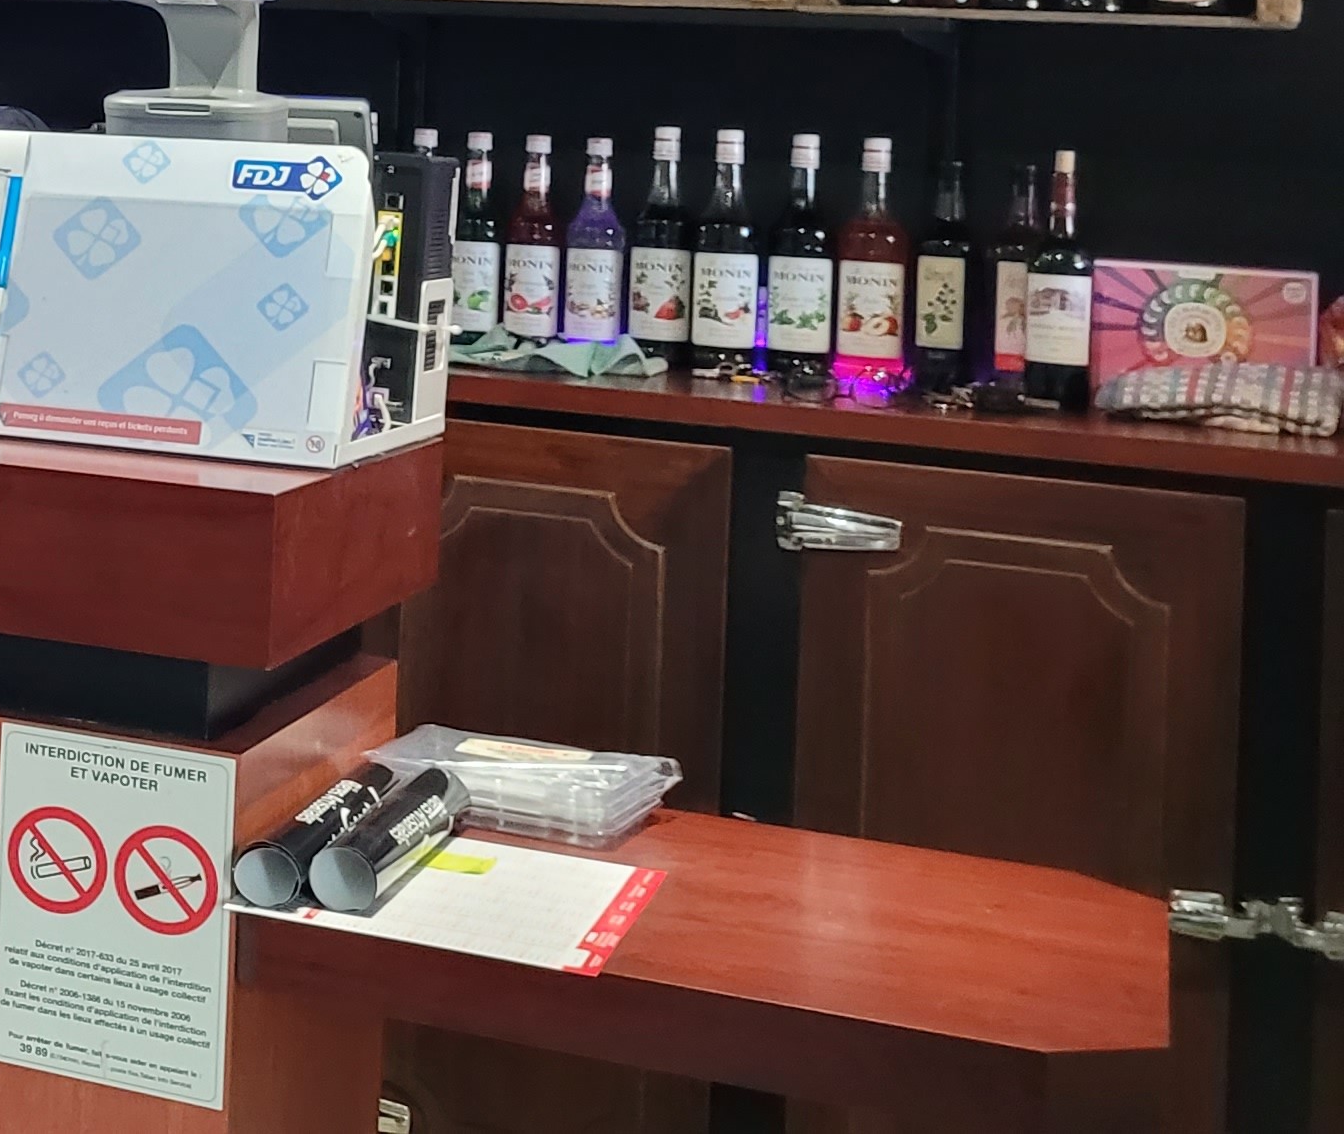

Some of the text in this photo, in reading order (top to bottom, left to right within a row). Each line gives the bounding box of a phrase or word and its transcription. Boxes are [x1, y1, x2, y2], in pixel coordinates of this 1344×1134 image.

[236, 165, 291, 189] FDJ
[635, 261, 684, 273] MONIN
[700, 267, 752, 279] MONIN
[773, 271, 826, 283] MONIN
[845, 275, 898, 287] MONIN
[25, 742, 207, 783] INTERDICTION DE FUMER
[70, 767, 158, 792] ET VAPOTER
[5, 945, 28, 956] relatif
[30, 952, 45, 960] aux
[47, 953, 91, 970] conditions
[93, 963, 148, 982] d'application
[149, 974, 160, 984] de
[35, 939, 63, 953] Décret
[116, 955, 127, 965] du
[141, 961, 160, 971] avril
[162, 965, 183, 976] 2017
[20, 1043, 48, 1057] 39 89
